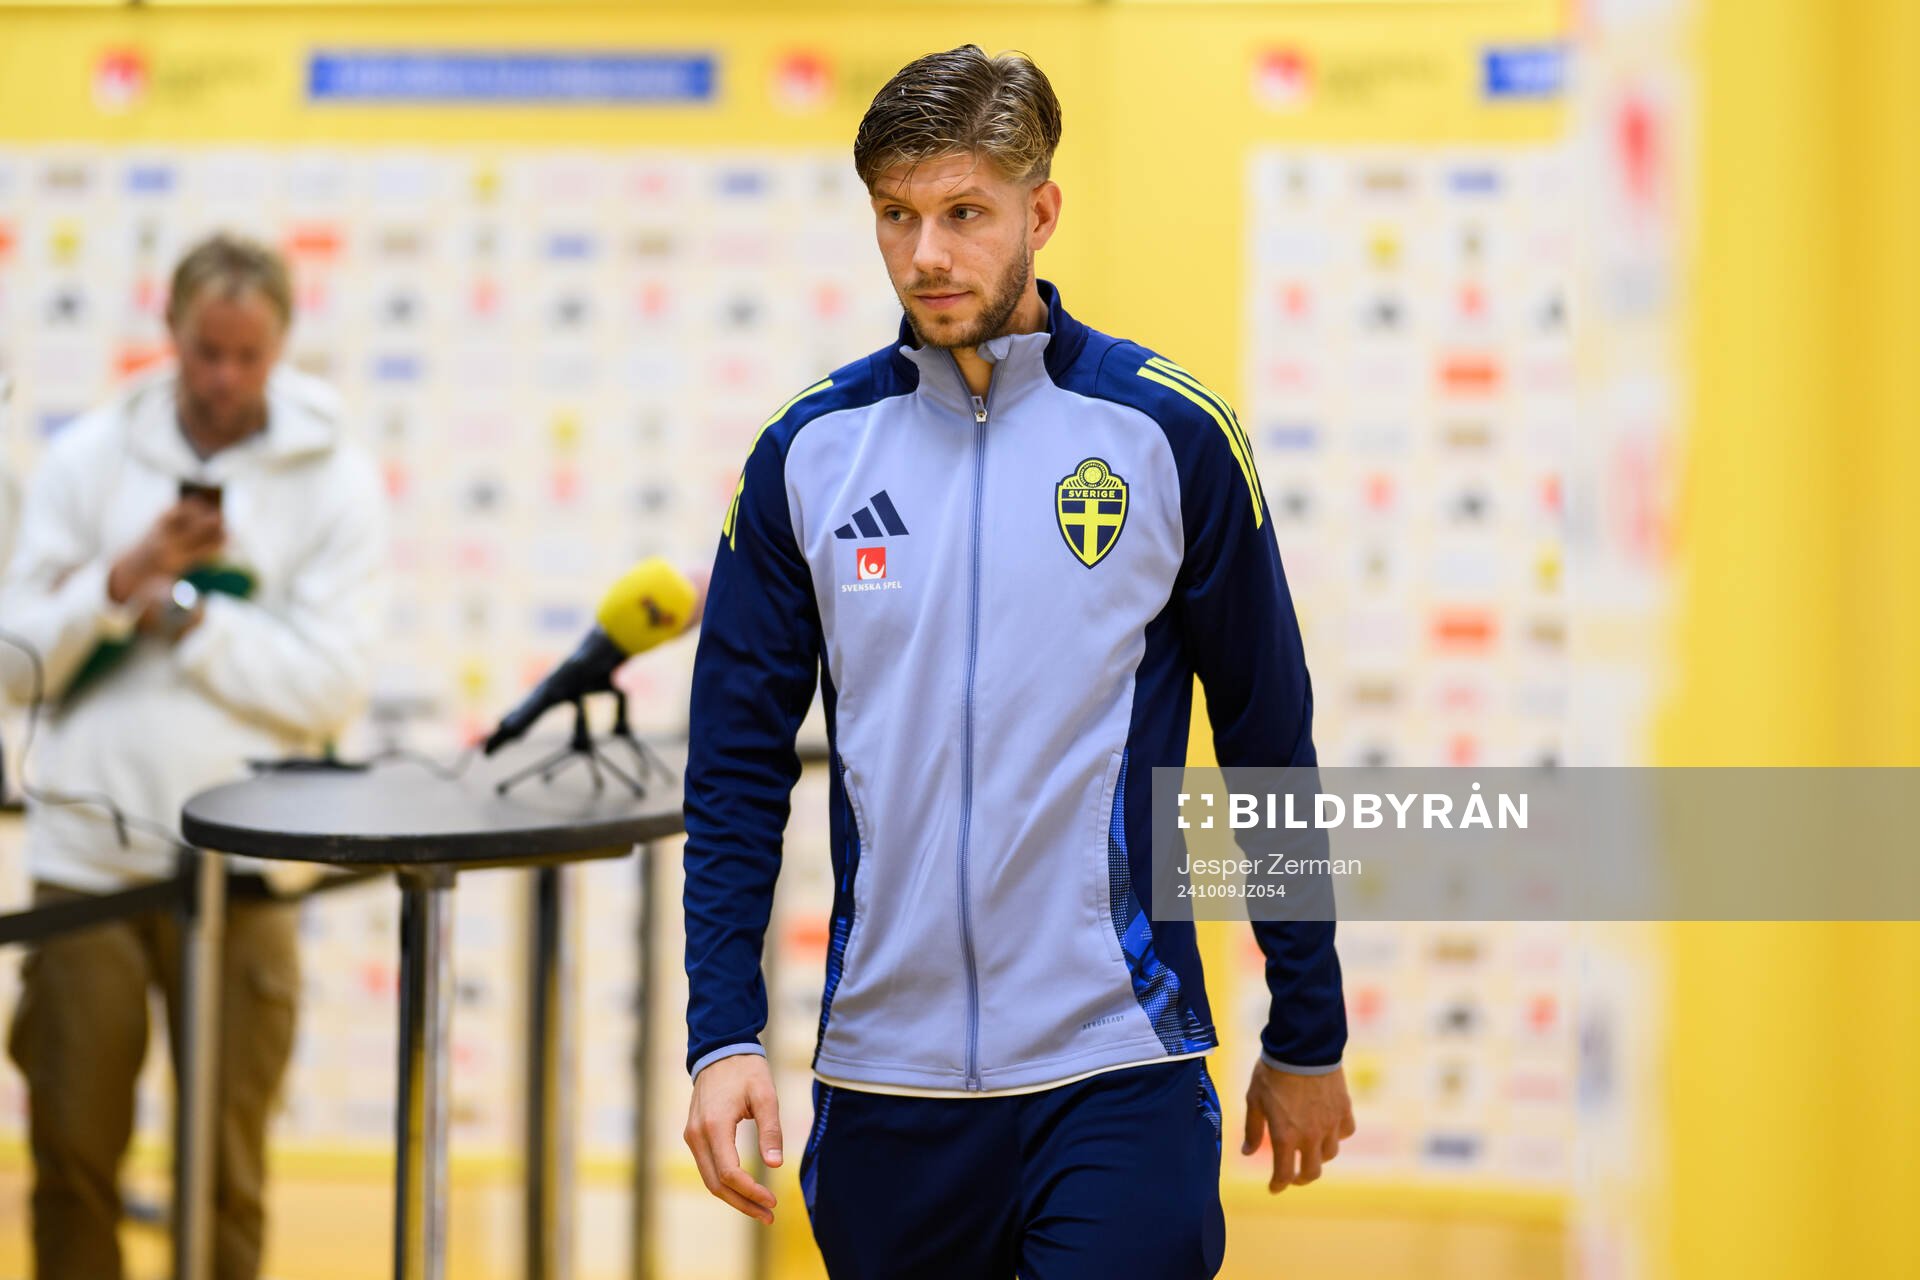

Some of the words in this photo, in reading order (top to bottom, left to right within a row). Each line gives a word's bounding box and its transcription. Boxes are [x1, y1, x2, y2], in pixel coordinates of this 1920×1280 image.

[1068, 490, 1116, 498] SVERIGE
[841, 583, 881, 593] SVENSKA
[883, 581, 903, 590] SPEL
